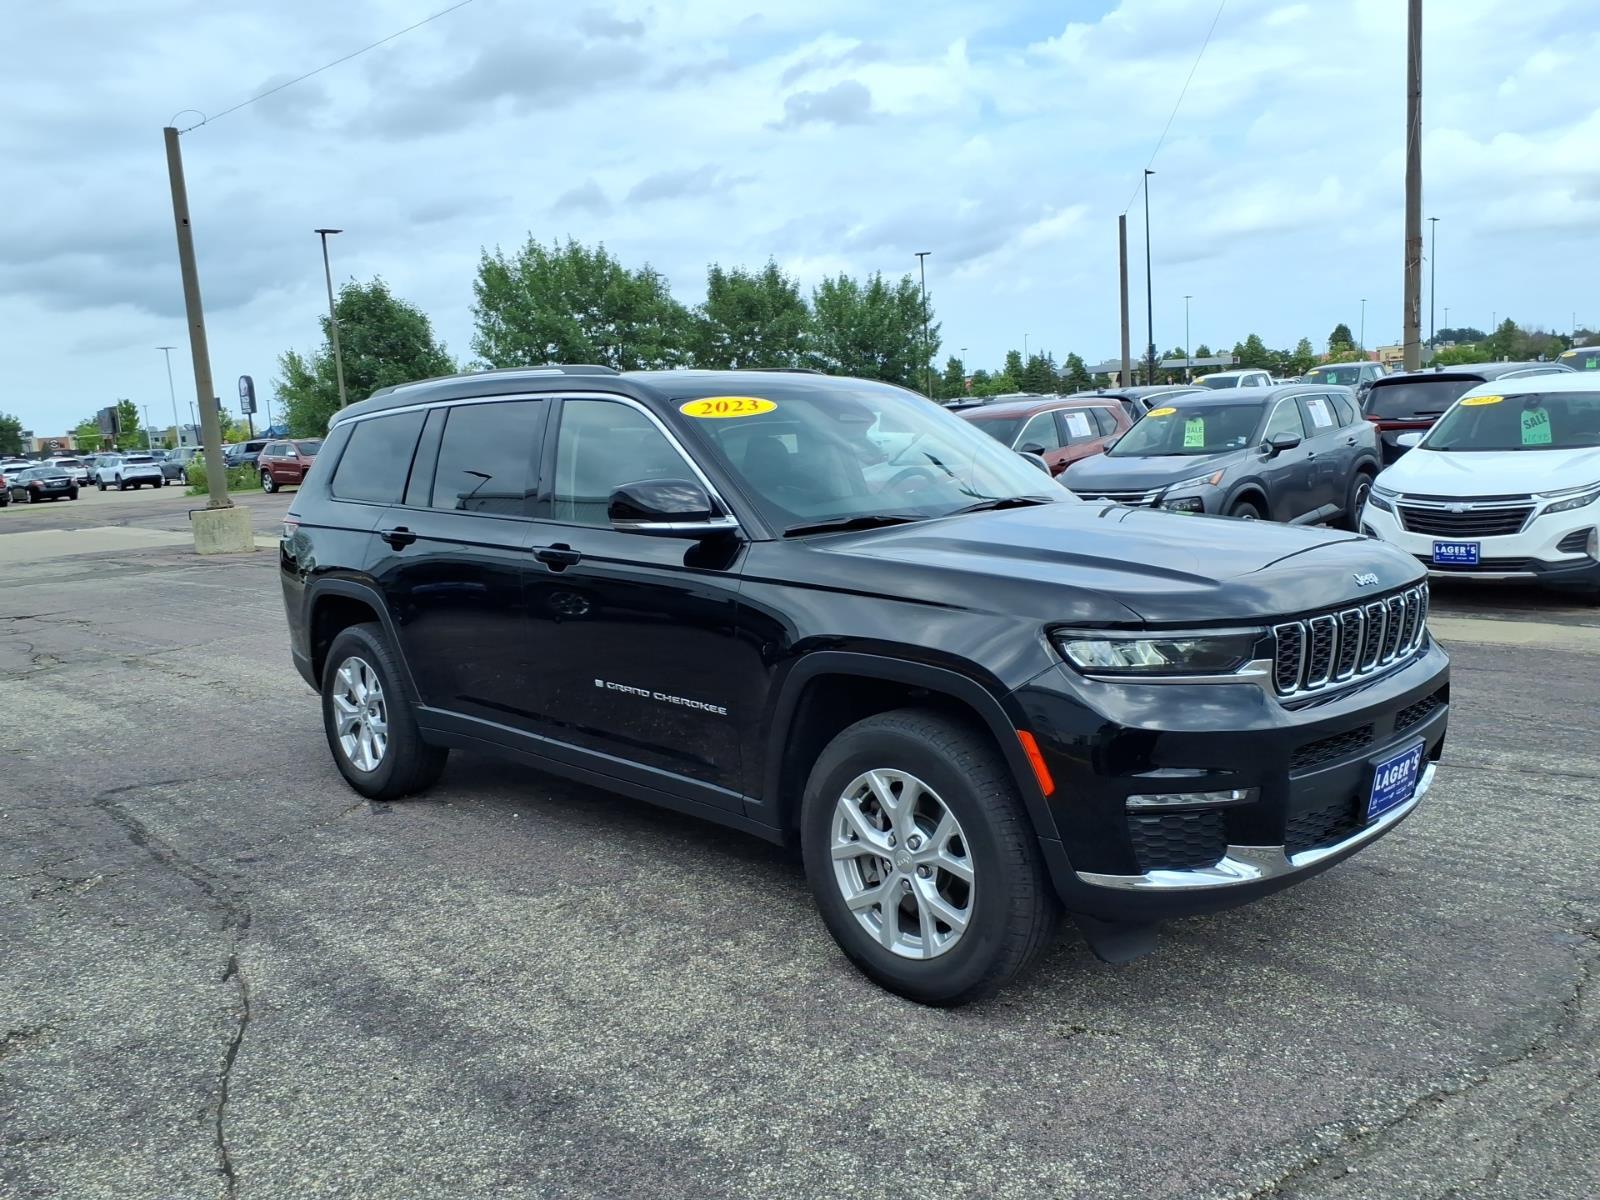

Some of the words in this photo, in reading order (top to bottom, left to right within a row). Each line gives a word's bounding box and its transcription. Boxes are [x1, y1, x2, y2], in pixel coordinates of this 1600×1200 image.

[700, 399, 759, 415] 2023
[1523, 412, 1548, 430] SALE
[1186, 426, 1204, 434] SALE
[1435, 546, 1476, 554] LAGER'S
[1353, 573, 1379, 587] Jeep
[606, 681, 650, 698] GRAND
[652, 692, 728, 716] CHEROKEE
[1375, 753, 1420, 791] LAGER'S
